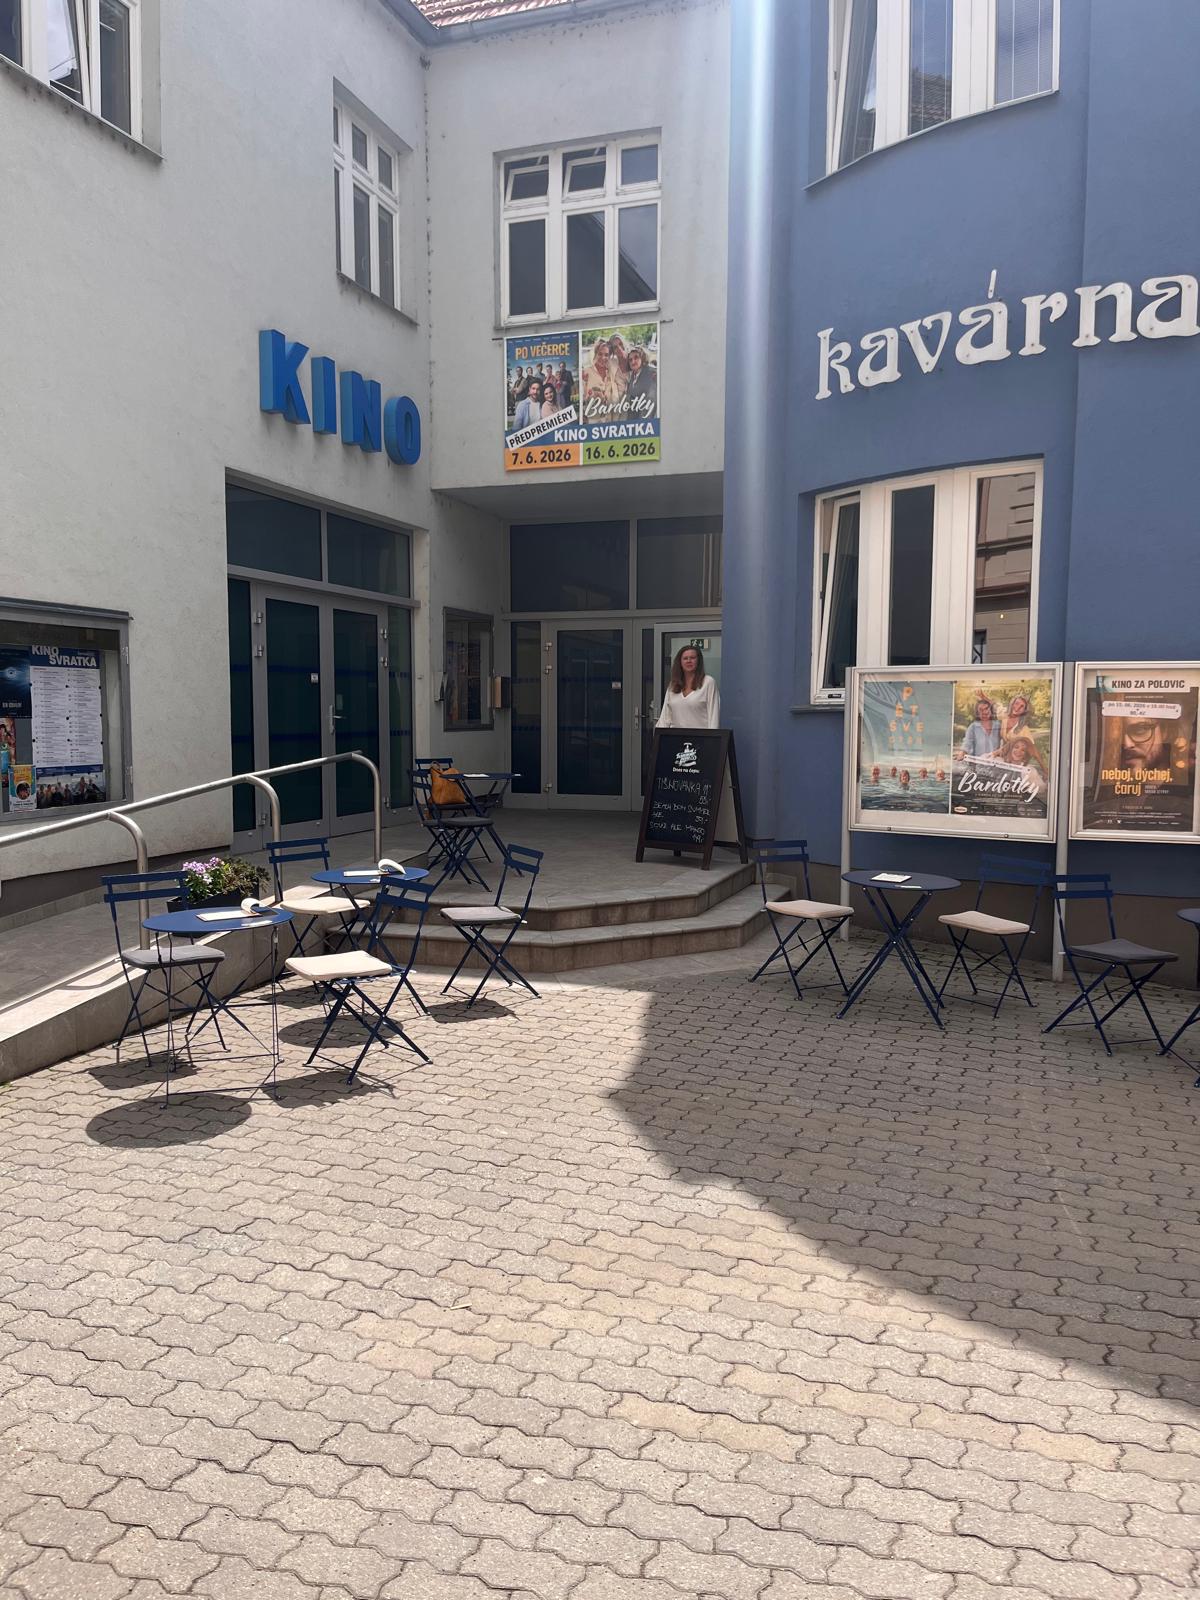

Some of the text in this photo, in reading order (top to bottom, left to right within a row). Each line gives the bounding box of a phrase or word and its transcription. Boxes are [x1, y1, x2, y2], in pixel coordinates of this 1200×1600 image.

[815, 269, 1200, 400] kavárna
[515, 342, 570, 361] PO VEČERCE
[258, 329, 421, 466] KINO
[584, 393, 655, 419] Bardotky
[509, 409, 574, 447] PŘEDPREMIÉRY
[554, 422, 654, 442] KINO SVRATKA
[31, 644, 59, 656] KINO
[48, 655, 97, 667] SVRATKA
[1111, 680, 1185, 689] KINO ZA POLOVIC
[957, 771, 1039, 803] Bardotky
[1114, 782, 1142, 796] čaruj
